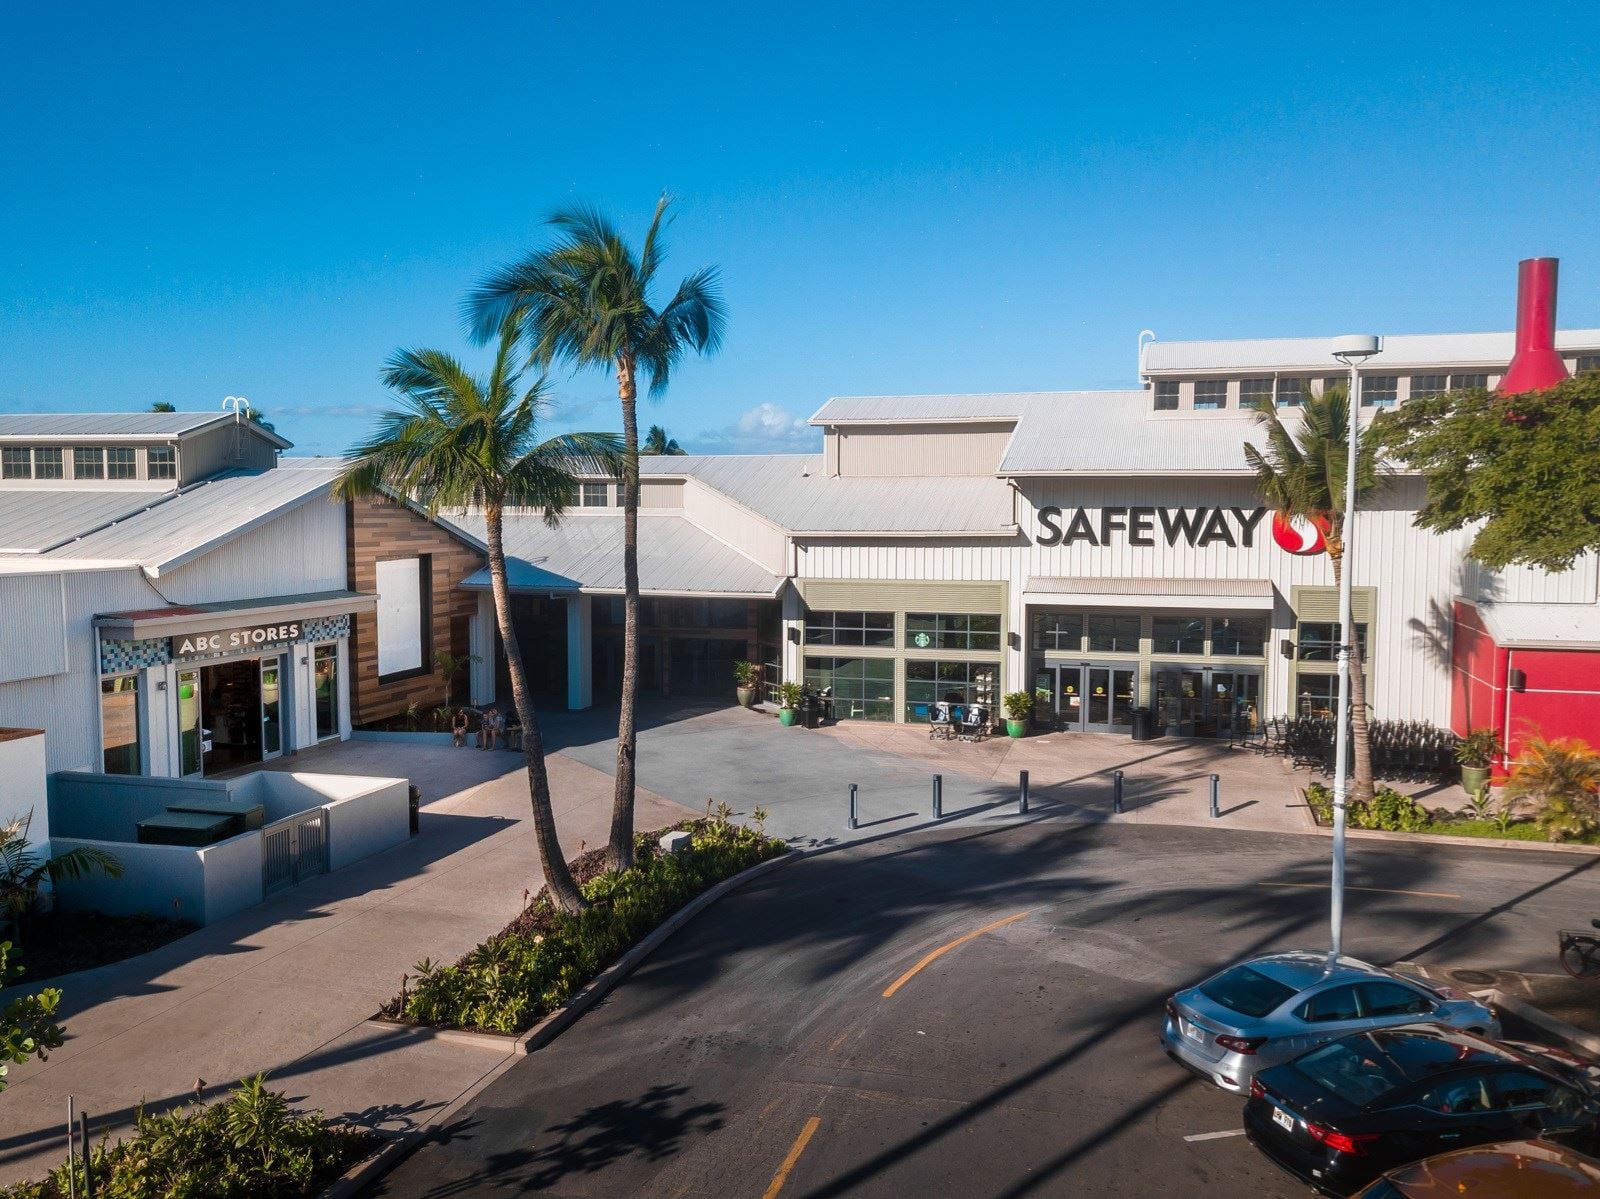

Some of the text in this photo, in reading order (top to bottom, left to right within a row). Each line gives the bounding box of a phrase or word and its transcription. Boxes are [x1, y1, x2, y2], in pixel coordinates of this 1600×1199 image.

[1036, 506, 1268, 548] SAFEWAY
[179, 624, 299, 654] ABC STORES
